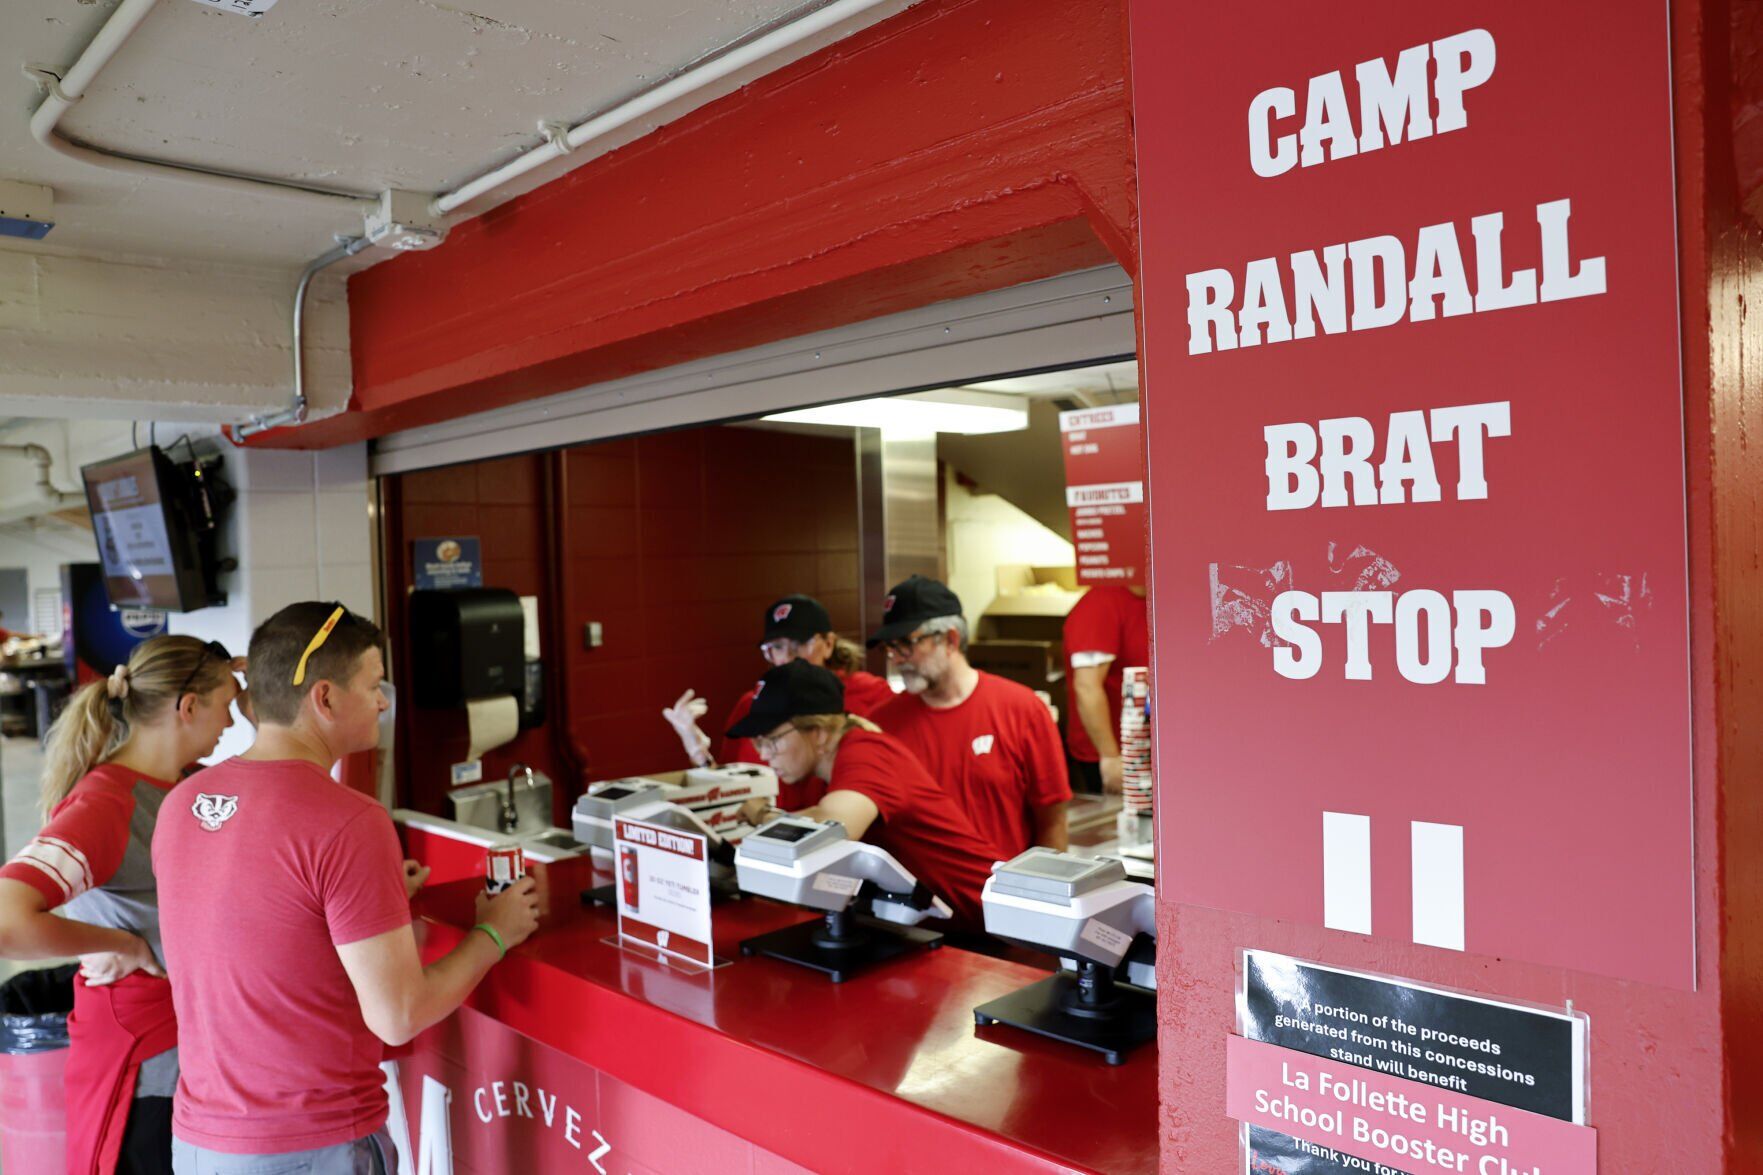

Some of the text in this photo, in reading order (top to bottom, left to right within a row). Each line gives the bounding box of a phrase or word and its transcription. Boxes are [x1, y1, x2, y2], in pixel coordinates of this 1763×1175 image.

[1248, 28, 1496, 178] CAMP
[1185, 198, 1607, 356] RANDALL
[1075, 488, 1130, 501] FAVORITES
[1263, 401, 1512, 511] BRAT
[1271, 589, 1516, 684] STOP
[623, 823, 657, 846] LIMITED
[1274, 1014, 1535, 1086] generated from this concessions
[1314, 1003, 1368, 1025] portion
[1372, 1016, 1388, 1029] of
[1391, 1019, 1417, 1036] the
[1421, 1027, 1501, 1056] proceeds
[1330, 1048, 1468, 1091] stand will benefit
[474, 1081, 612, 1175] CERVEZ
[1255, 1089, 1343, 1136] School
[1353, 1117, 1469, 1173] Booster
[1282, 1062, 1509, 1147] La Follette High
[1292, 1136, 1339, 1162] Thank
[1342, 1154, 1370, 1172] you
